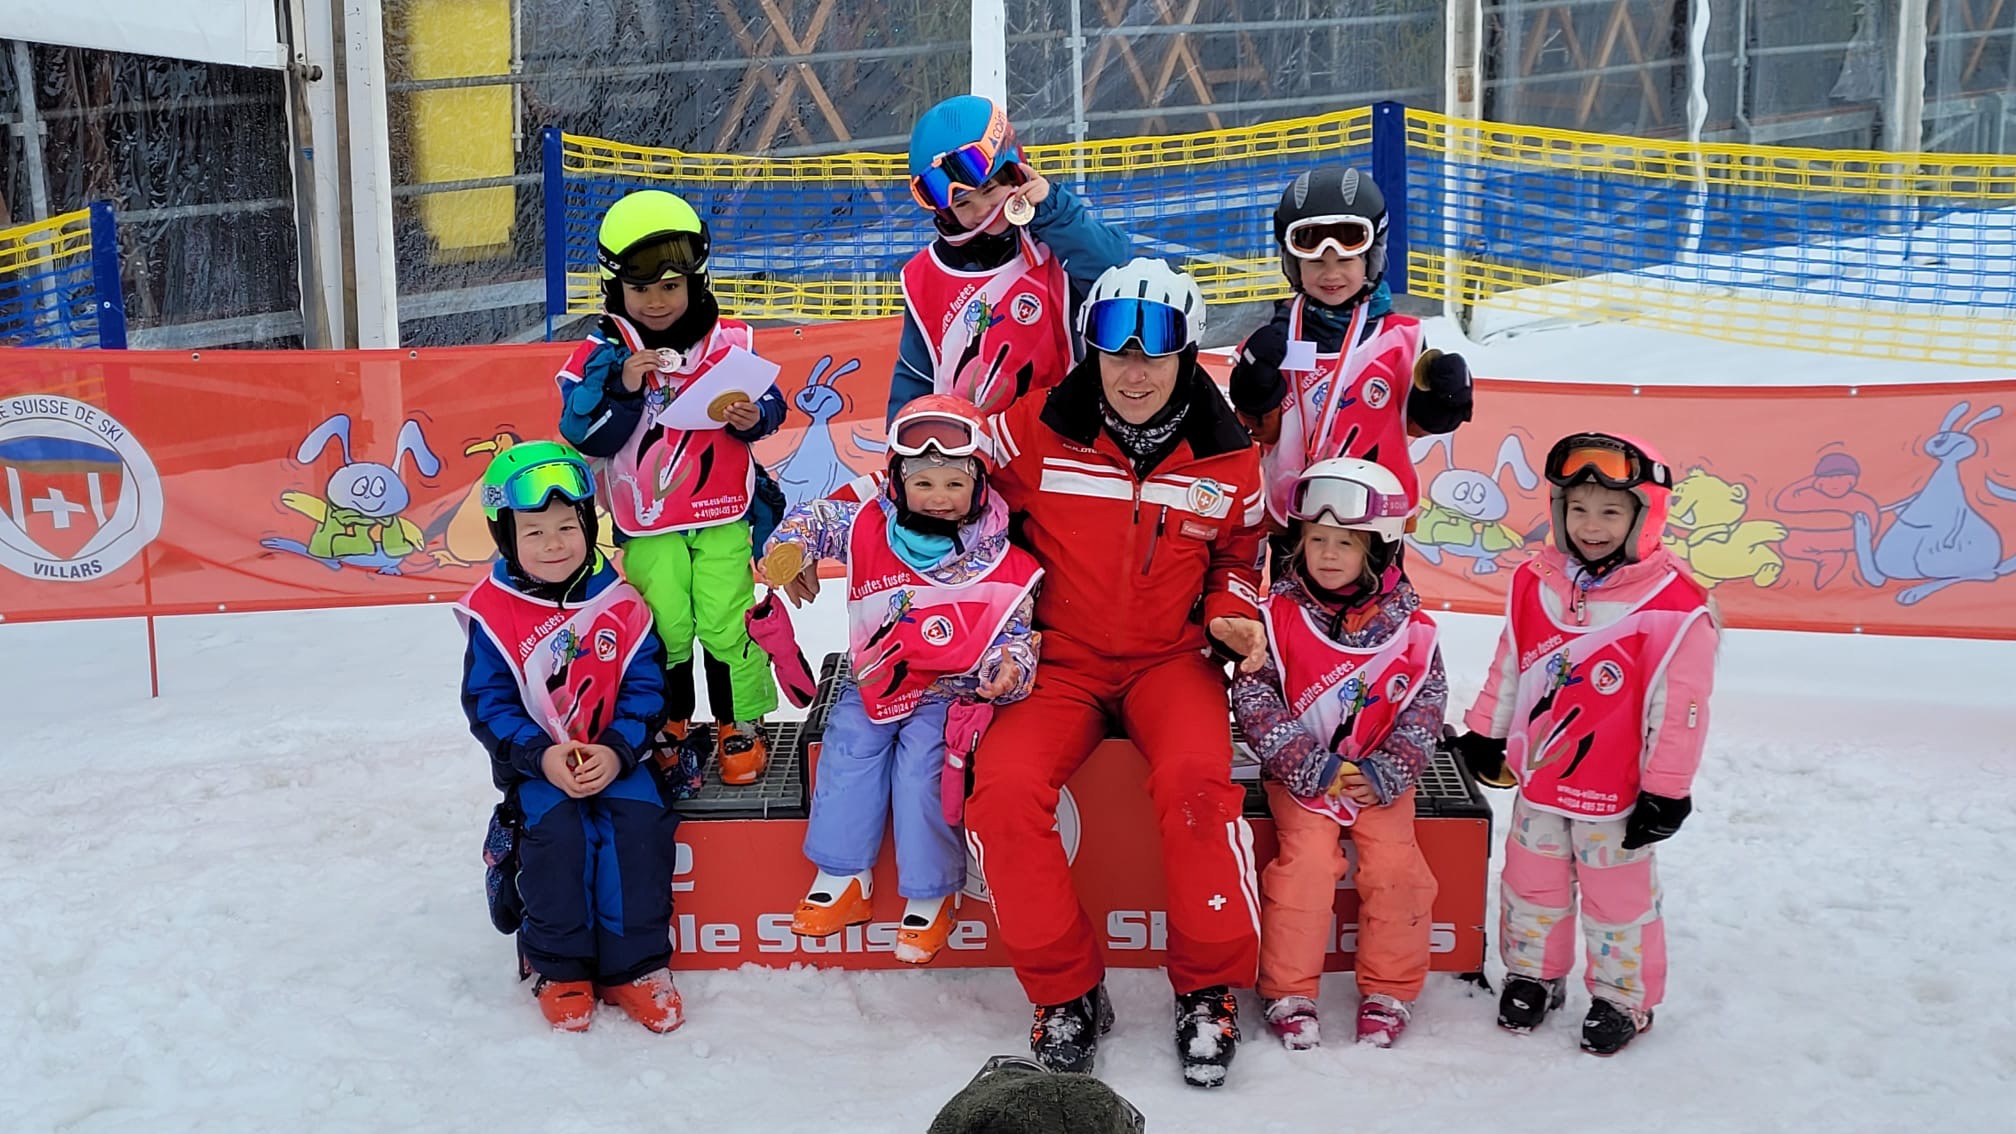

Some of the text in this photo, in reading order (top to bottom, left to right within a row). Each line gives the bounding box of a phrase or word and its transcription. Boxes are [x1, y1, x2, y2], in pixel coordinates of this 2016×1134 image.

[12, 398, 69, 416] SUISSE
[74, 406, 96, 425] DE
[98, 420, 124, 442] SKI
[33, 559, 103, 578] VILLARS
[1294, 682, 1324, 713] petites
[1320, 660, 1355, 687] fusées
[757, 913, 988, 953] Suise
